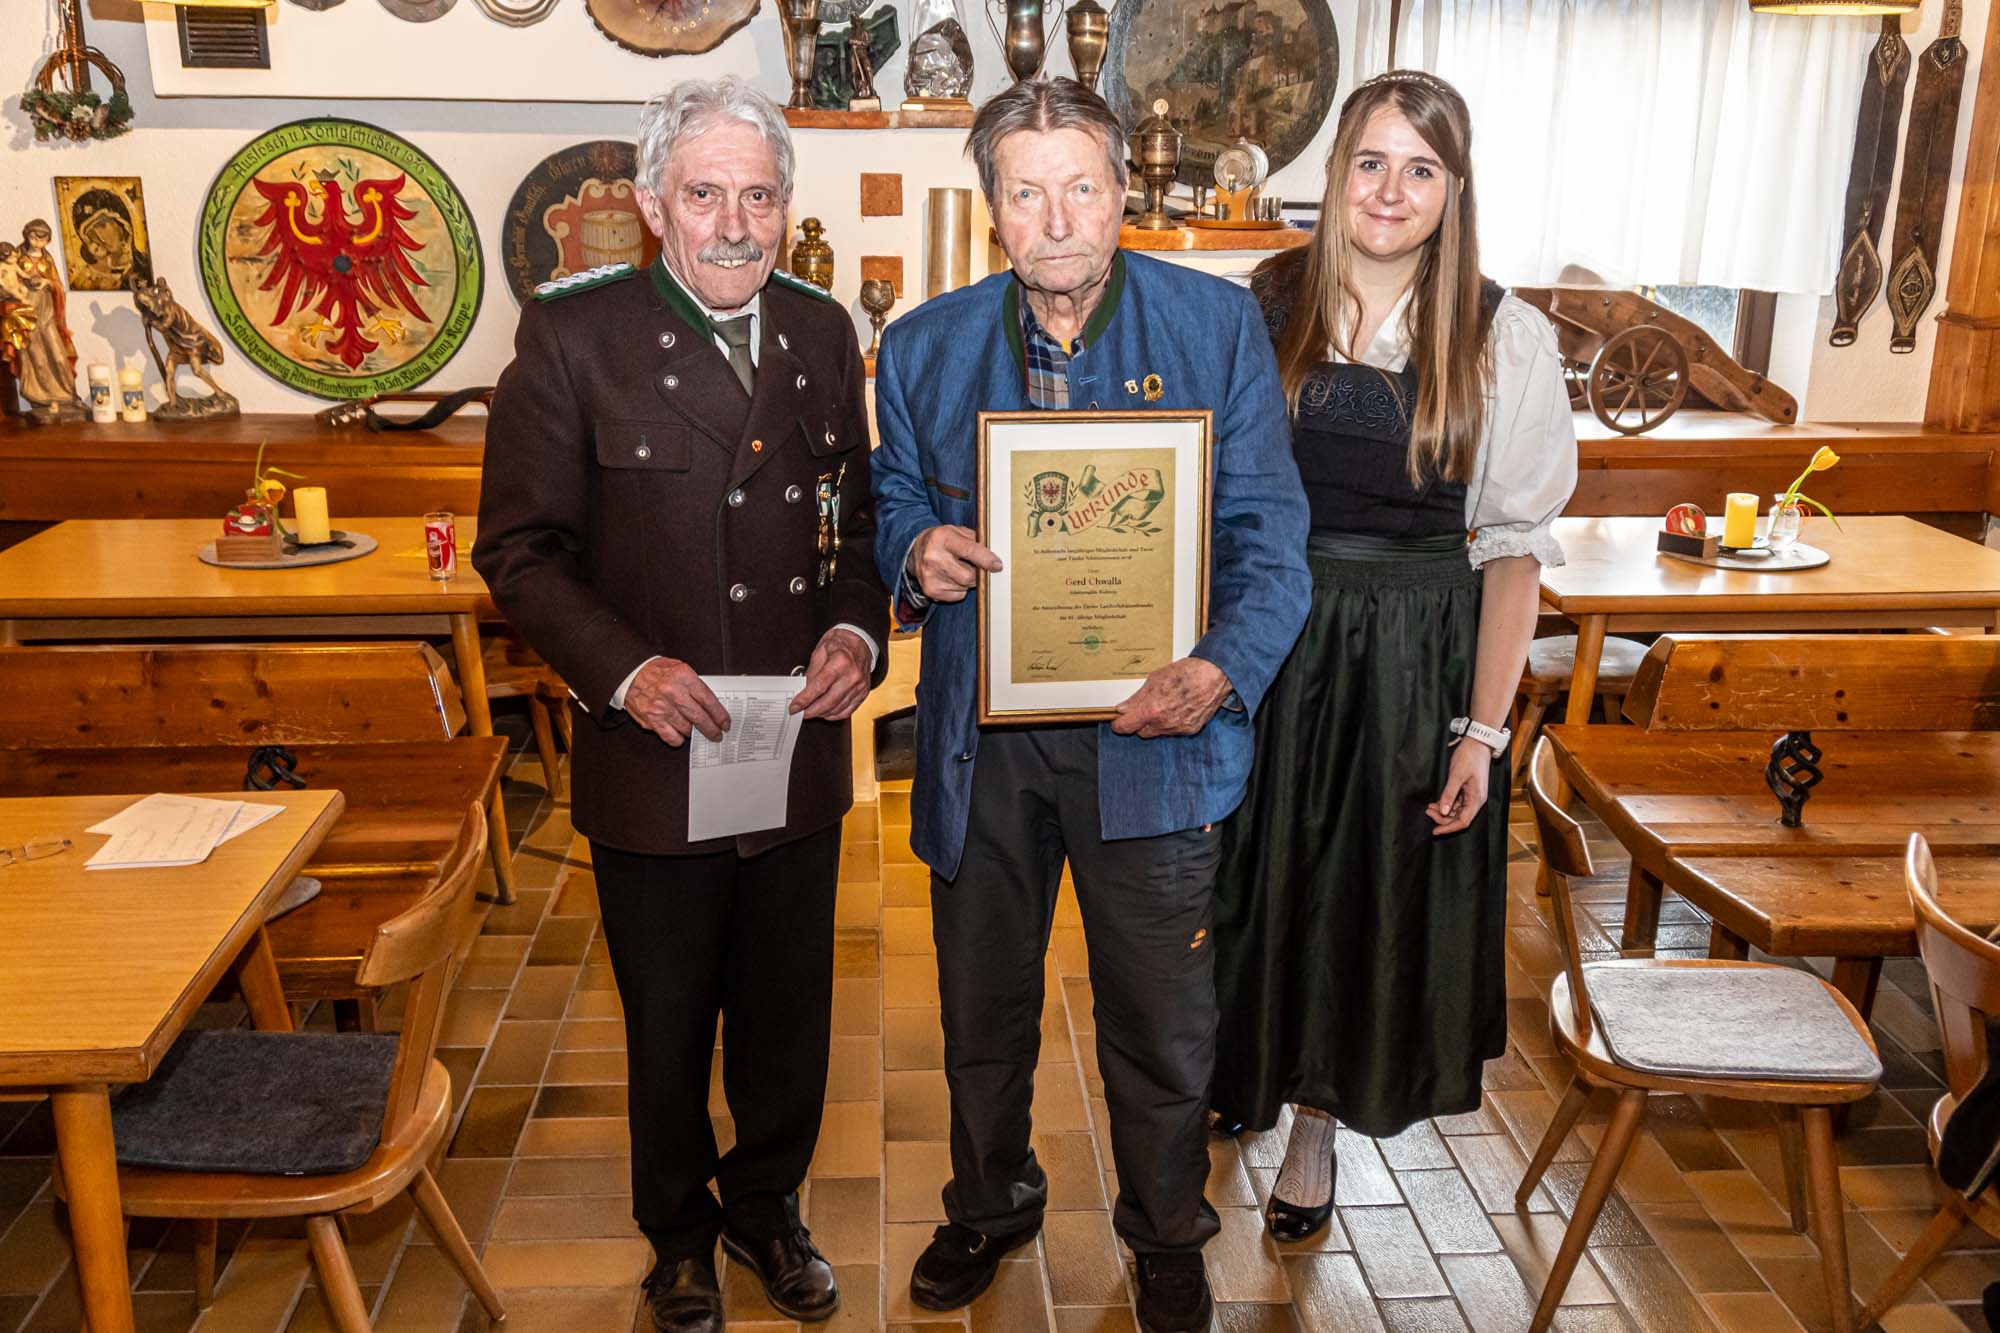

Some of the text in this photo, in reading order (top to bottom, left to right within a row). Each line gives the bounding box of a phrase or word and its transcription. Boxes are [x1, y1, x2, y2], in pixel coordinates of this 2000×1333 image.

[1067, 471, 1149, 529] Urkunde
[1065, 576, 1122, 586] Gerd Chwalla
